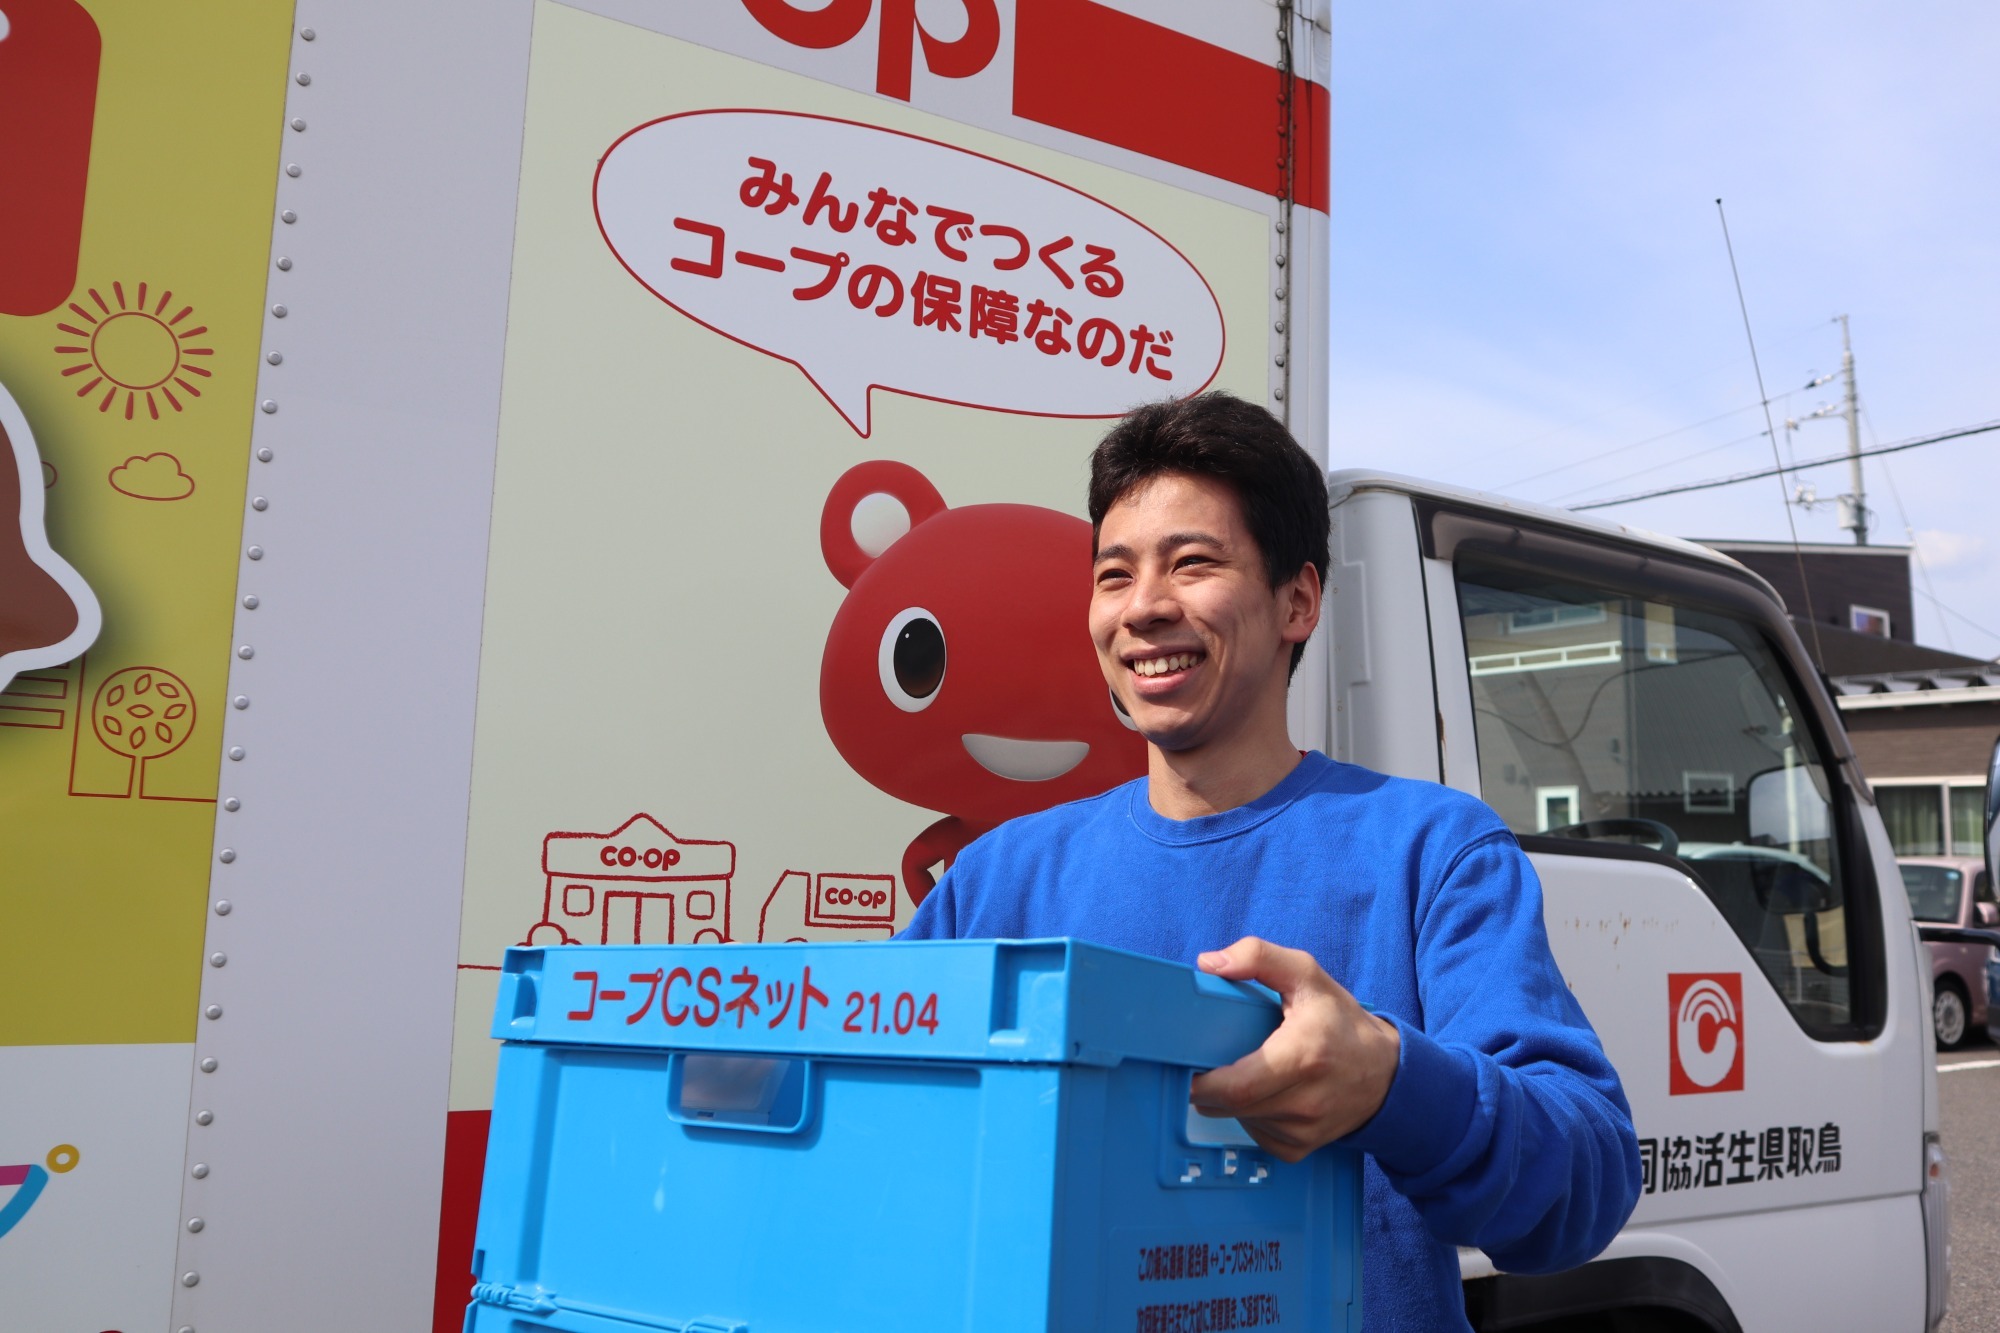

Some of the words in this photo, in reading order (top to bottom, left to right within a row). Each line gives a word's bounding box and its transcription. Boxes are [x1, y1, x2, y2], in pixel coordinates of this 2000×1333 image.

[739, 156, 1125, 298] みんなでつくる
[671, 217, 1173, 381] コープの保障なのだ
[568, 966, 829, 1029] コープCSネット
[844, 992, 939, 1035] 21.04
